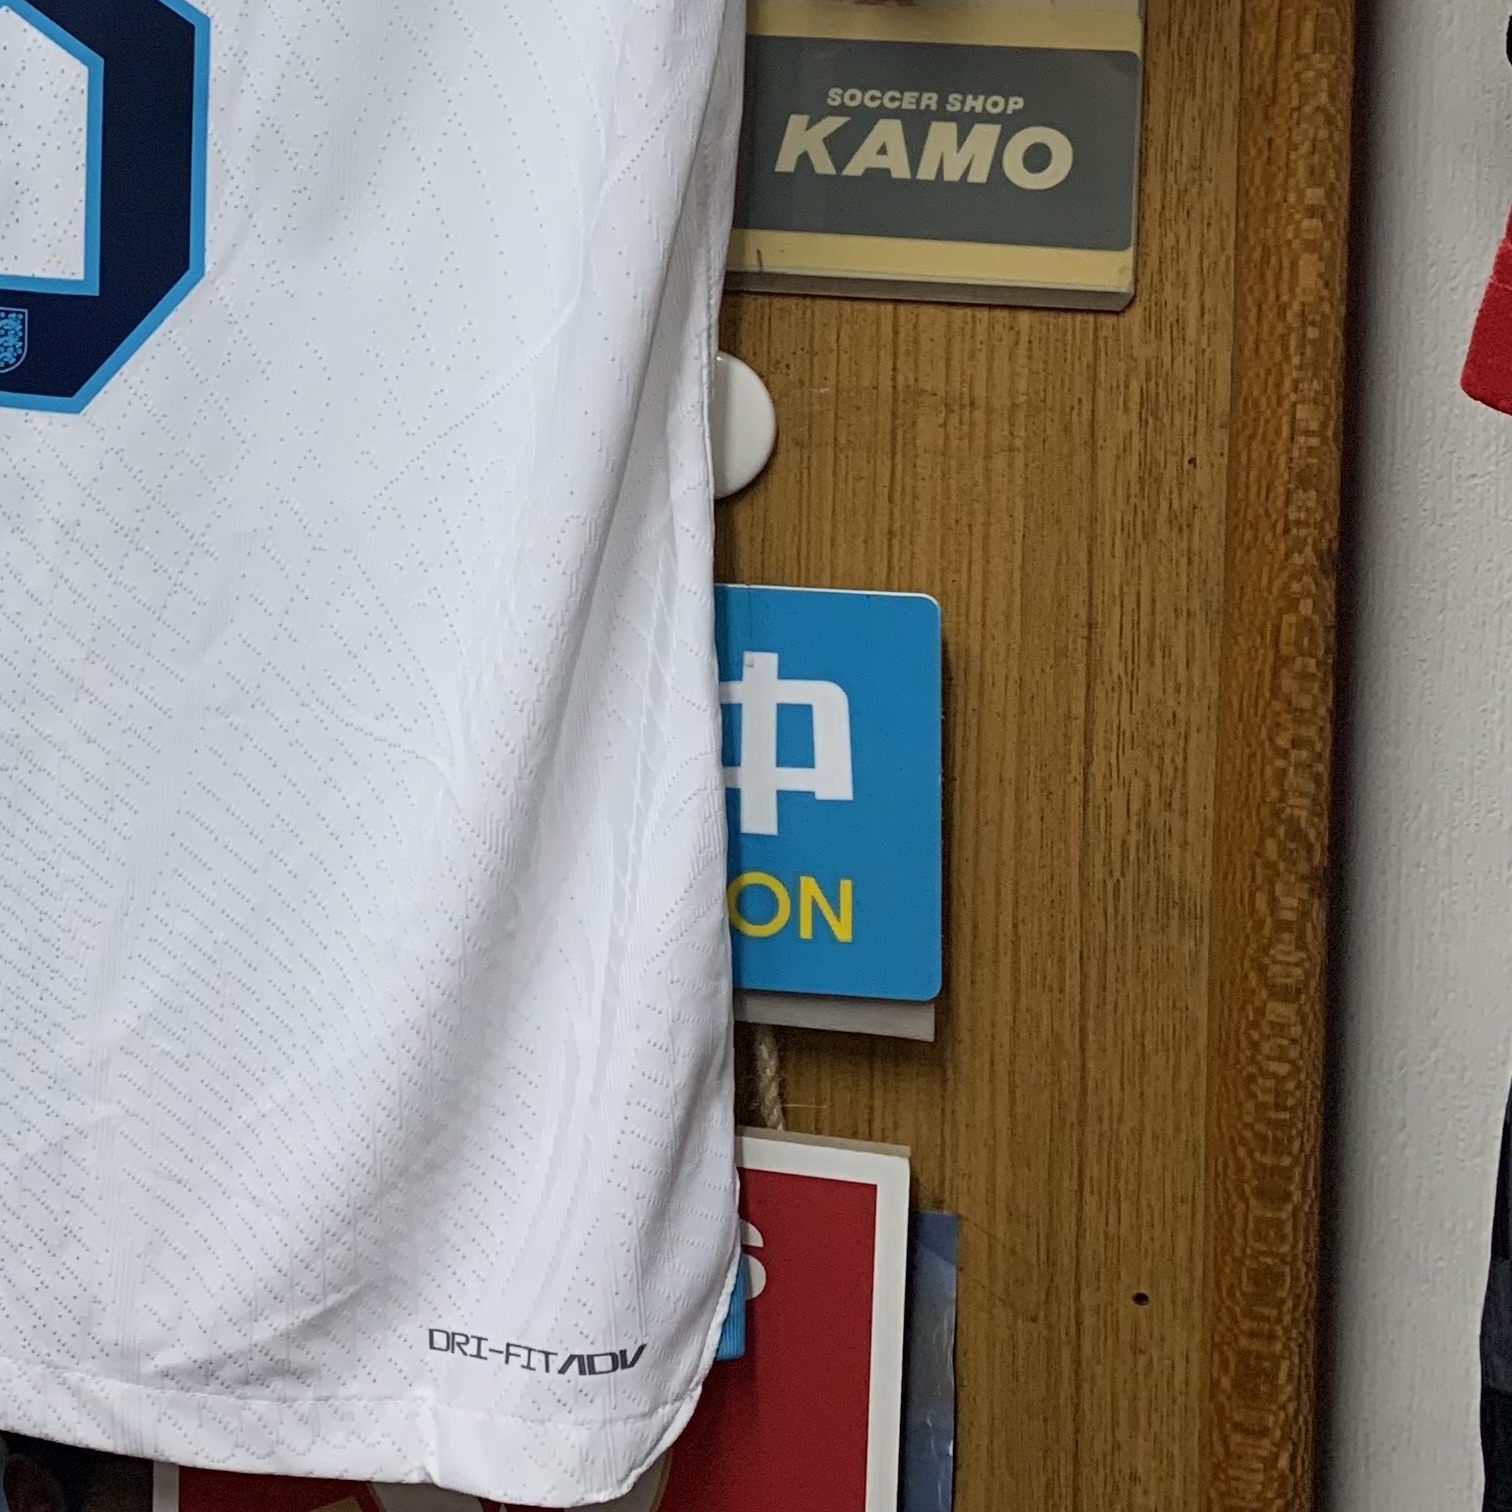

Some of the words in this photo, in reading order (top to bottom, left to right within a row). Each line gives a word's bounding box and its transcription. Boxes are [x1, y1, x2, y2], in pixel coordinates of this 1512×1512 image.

[826, 87, 938, 112] SOCCER
[945, 91, 1025, 116] SHOP
[774, 113, 1074, 190] KAMO
